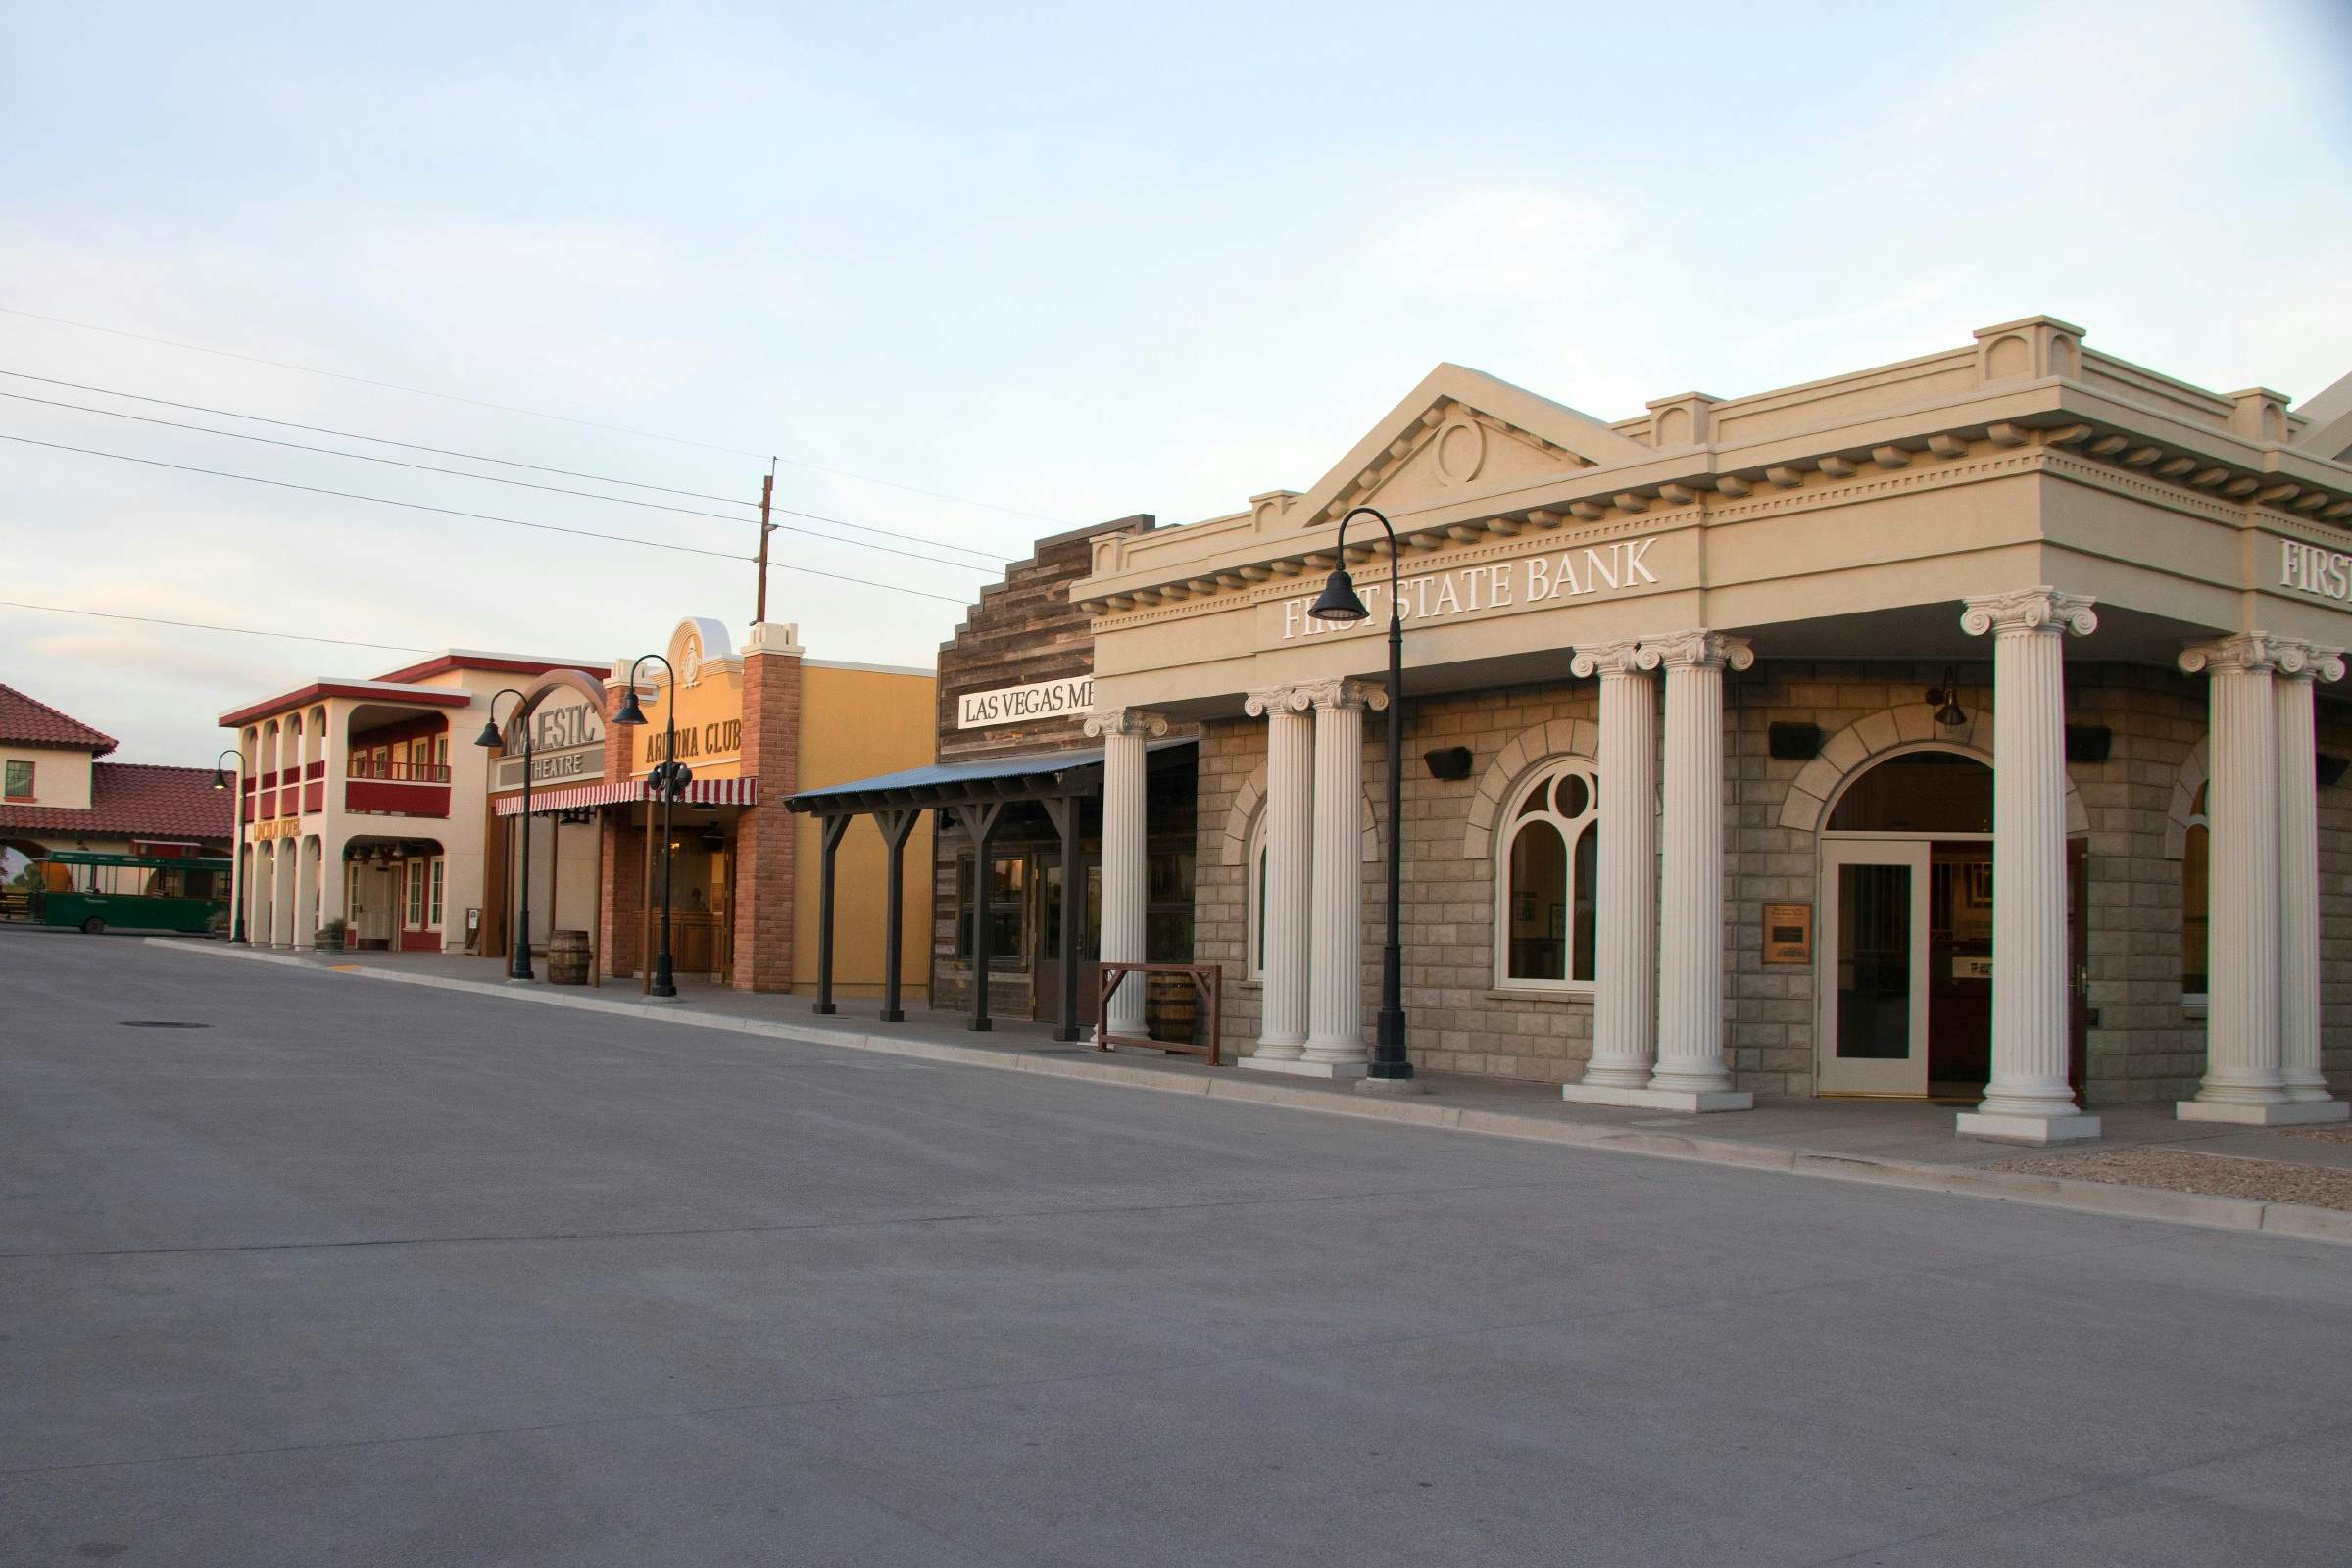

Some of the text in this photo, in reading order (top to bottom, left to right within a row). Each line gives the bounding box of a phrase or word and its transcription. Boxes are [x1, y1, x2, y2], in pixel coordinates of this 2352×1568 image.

[1282, 537, 1658, 639] FIT STATE BANK
[965, 696, 998, 722] LAS
[1002, 685, 1063, 717] VEGAS
[646, 718, 742, 763] ARIONA CLUB
